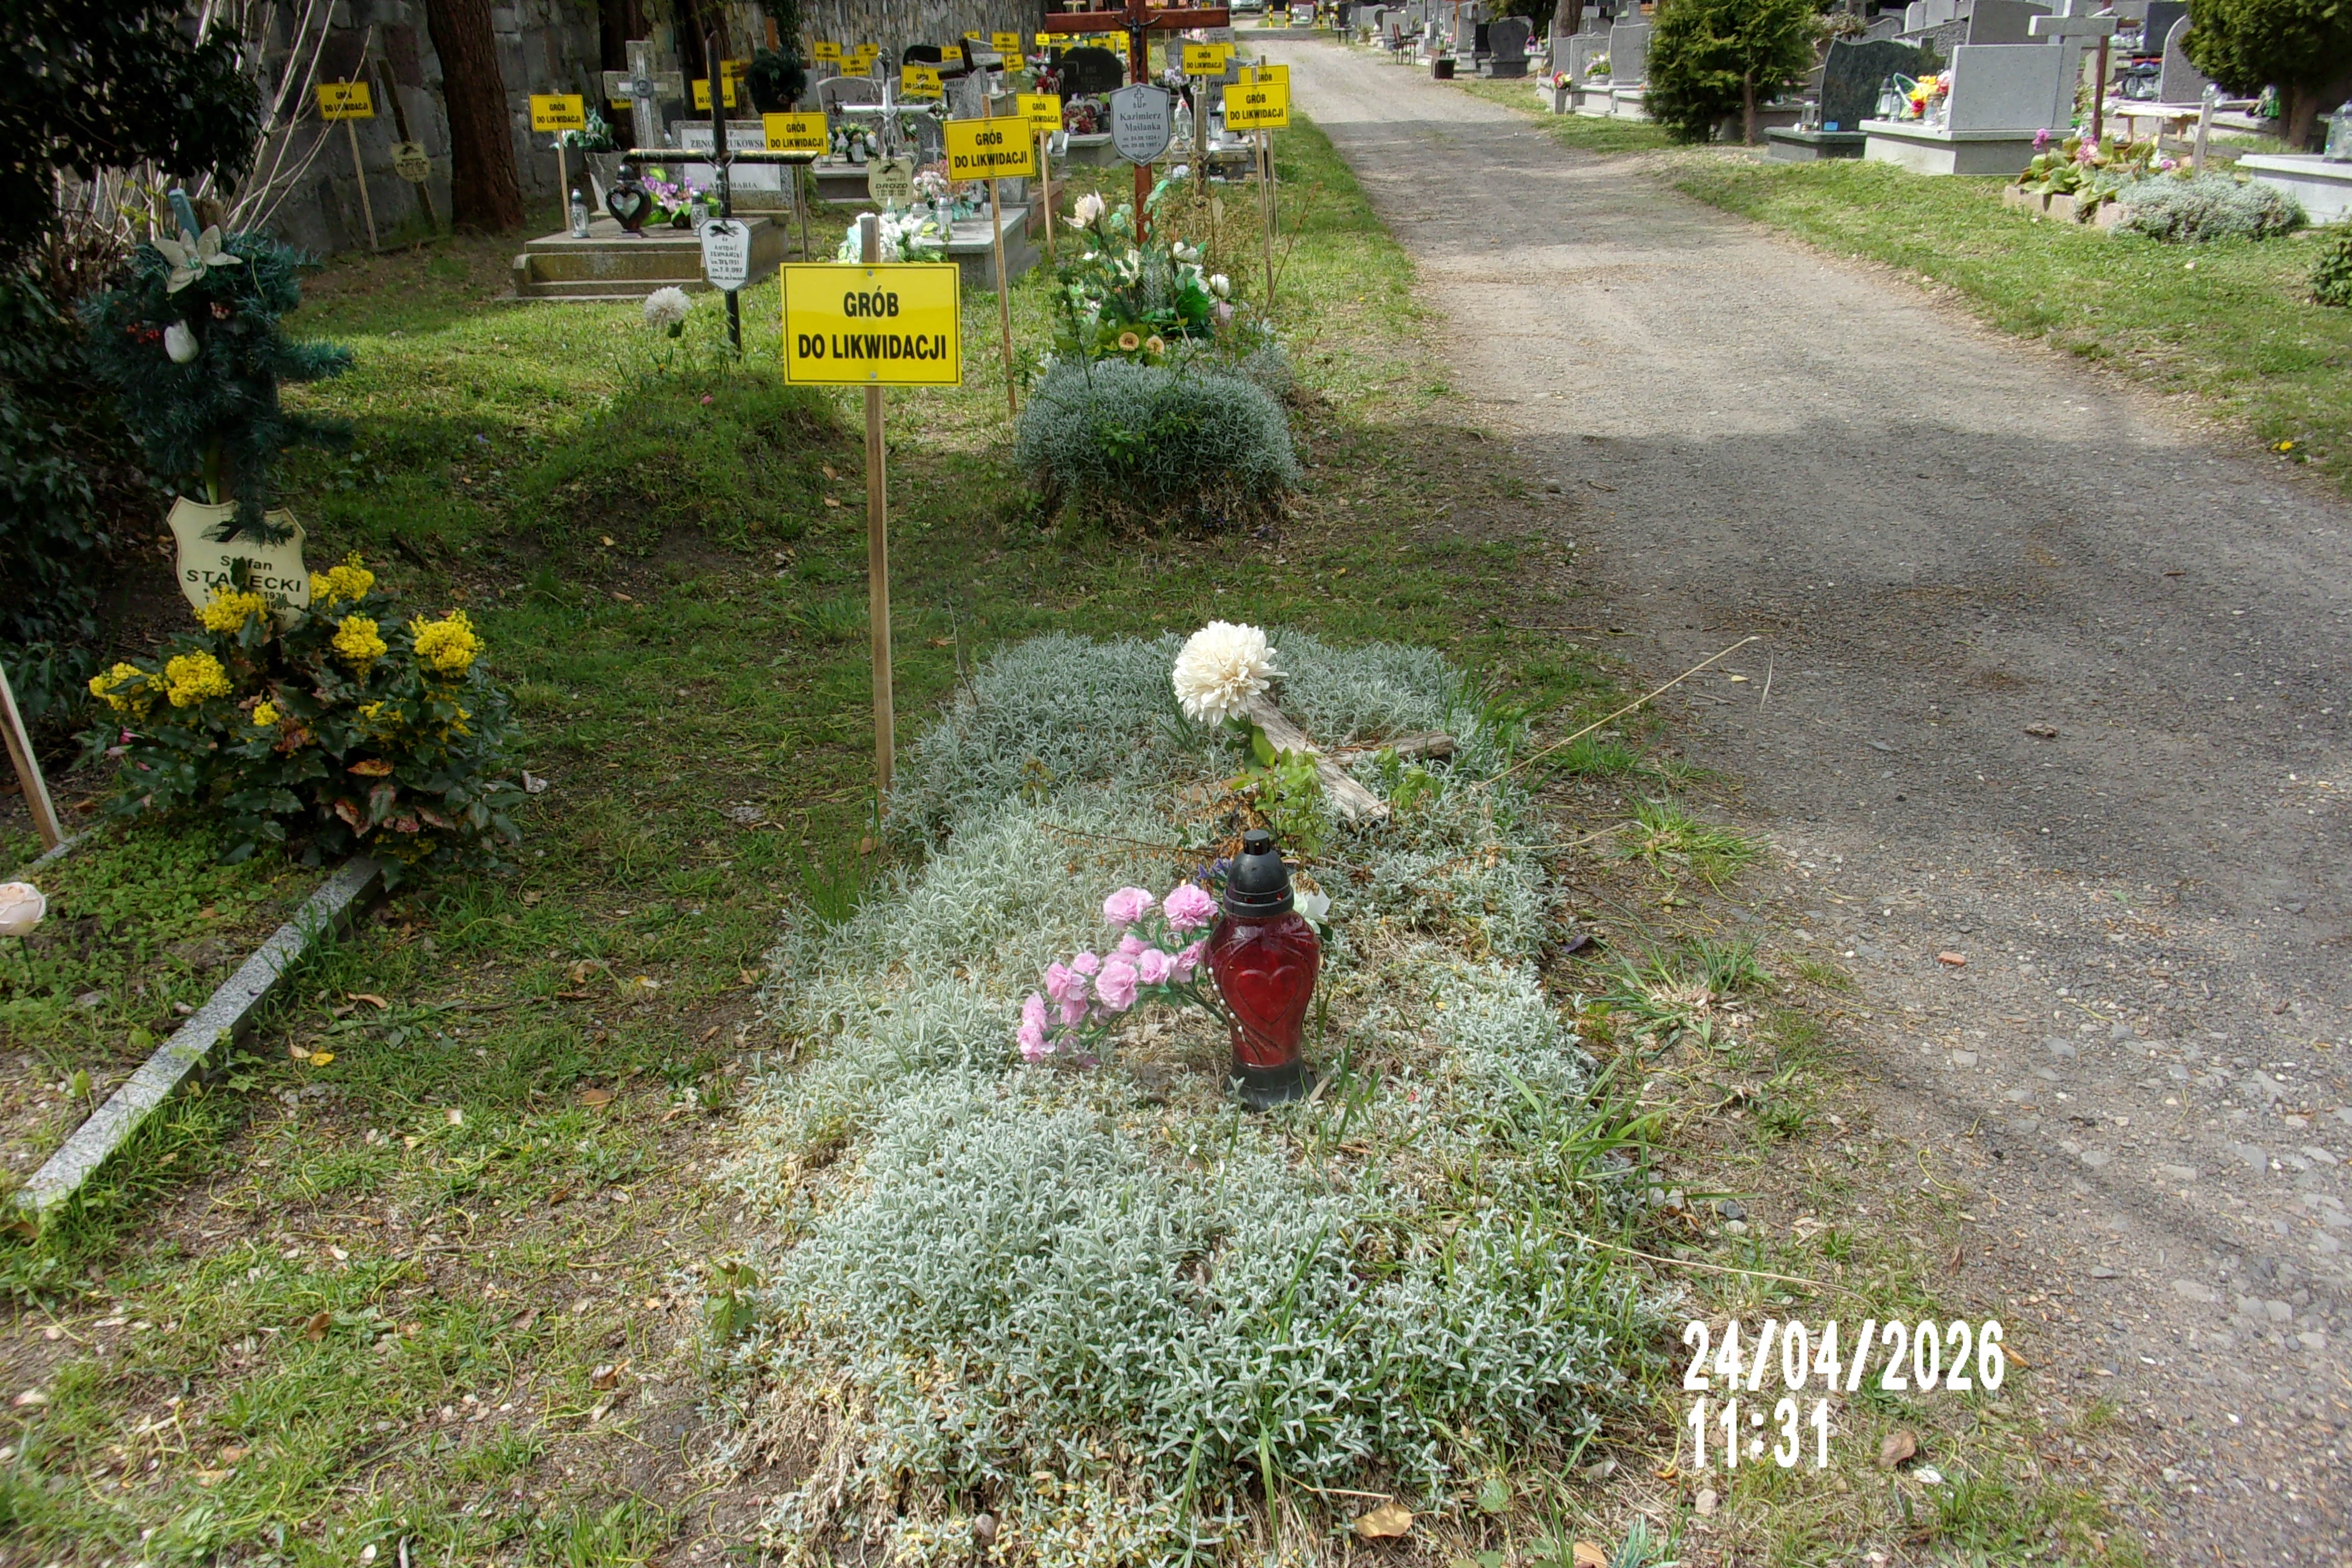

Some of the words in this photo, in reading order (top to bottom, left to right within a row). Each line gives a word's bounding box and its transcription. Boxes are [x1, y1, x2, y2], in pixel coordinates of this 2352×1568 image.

[904, 82, 912, 90] DO
[1246, 91, 1266, 104] GRÓB
[324, 104, 333, 112] DO
[549, 102, 566, 111] GRÓB
[1032, 101, 1046, 111] GRÓB
[1031, 114, 1059, 123] LIKWIDACJI
[1120, 112, 1161, 120] Kazimierz
[1230, 110, 1240, 120] DO
[1242, 108, 1284, 120] LIKWIDACJI
[786, 121, 806, 133] GRÓB
[1125, 122, 1160, 131] Maślanka
[771, 139, 781, 148] DO
[782, 137, 824, 148] LIKWIDACJI
[975, 129, 1002, 145] GRÓB
[690, 139, 714, 148] ZENO
[727, 139, 765, 148] UKOWSK
[954, 155, 968, 168] DO
[971, 151, 1028, 167] LIKWIDACJI
[843, 285, 899, 317] GRÓB
[798, 333, 825, 359] DO
[832, 334, 946, 360] LIKWIDACJI
[220, 555, 273, 571] Sfan
[186, 570, 301, 593] STAECKI
